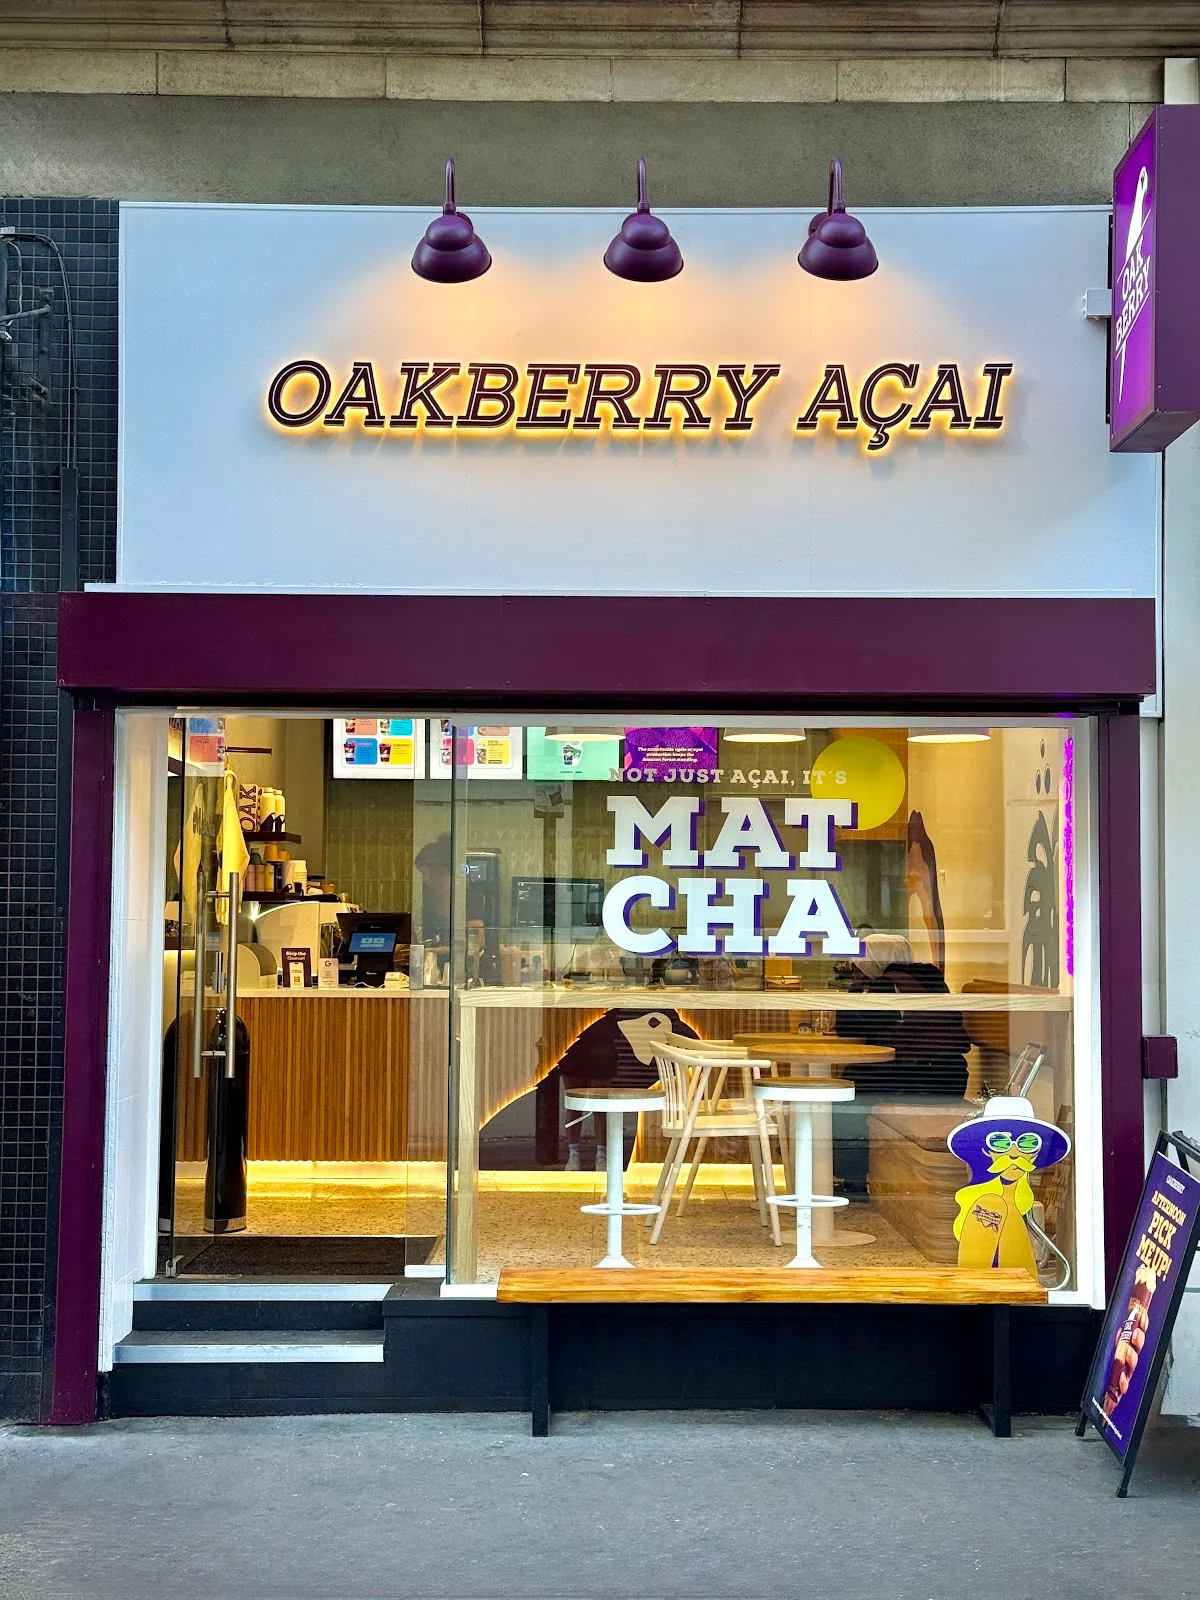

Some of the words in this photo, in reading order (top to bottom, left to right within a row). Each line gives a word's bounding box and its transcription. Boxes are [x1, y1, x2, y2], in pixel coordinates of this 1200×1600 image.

[1122, 234, 1144, 302] OAK
[1115, 254, 1151, 352] BERRY
[267, 360, 781, 431] OAKBERRY
[796, 361, 1014, 451] AÇAI
[609, 767, 657, 783] NOT
[663, 768, 724, 785] JUST
[730, 769, 796, 788] AÇAI,
[240, 784, 257, 832] OAK
[606, 795, 859, 872] MAT
[601, 875, 867, 958] CHA
[1147, 1210, 1177, 1251] PICK
[1151, 1190, 1187, 1227] AFTERNOON
[1135, 1233, 1157, 1268] ME
